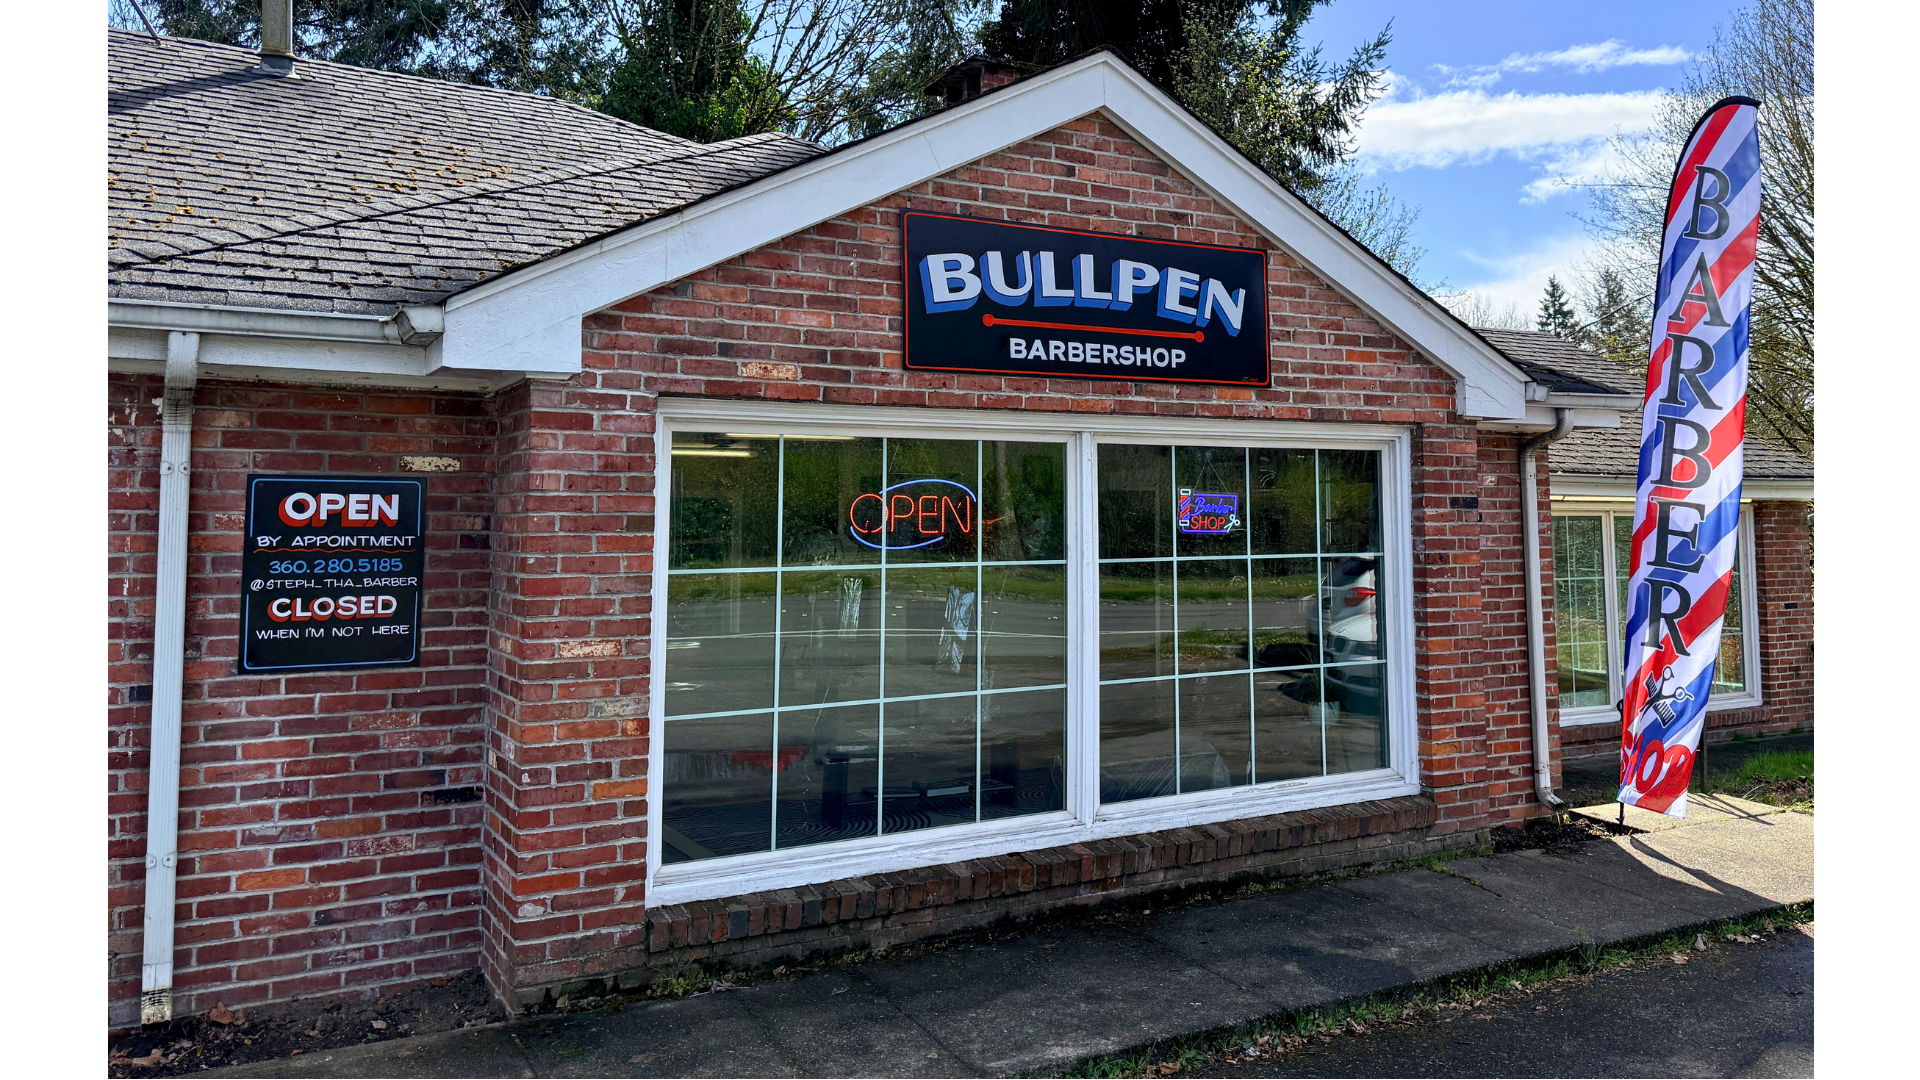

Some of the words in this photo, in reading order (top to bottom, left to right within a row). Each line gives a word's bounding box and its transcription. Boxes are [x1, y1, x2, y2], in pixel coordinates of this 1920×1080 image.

[919, 250, 1246, 337] BULLPEN
[1009, 338, 1186, 369] BARBERSHOP
[1640, 164, 1732, 657] BARBER
[278, 492, 400, 528] OPEN
[850, 493, 971, 534] OPEN
[1191, 497, 1233, 516] Barber
[1190, 515, 1226, 530] SHOP
[256, 535, 282, 547] BY
[291, 535, 416, 547] APPOINTMENT
[269, 558, 403, 574] 360.280.5185
[267, 595, 398, 623] CLOSED
[256, 629, 300, 640] WHEN
[305, 627, 325, 638] I'M
[332, 626, 364, 637] NOT
[372, 624, 410, 635] HERE
